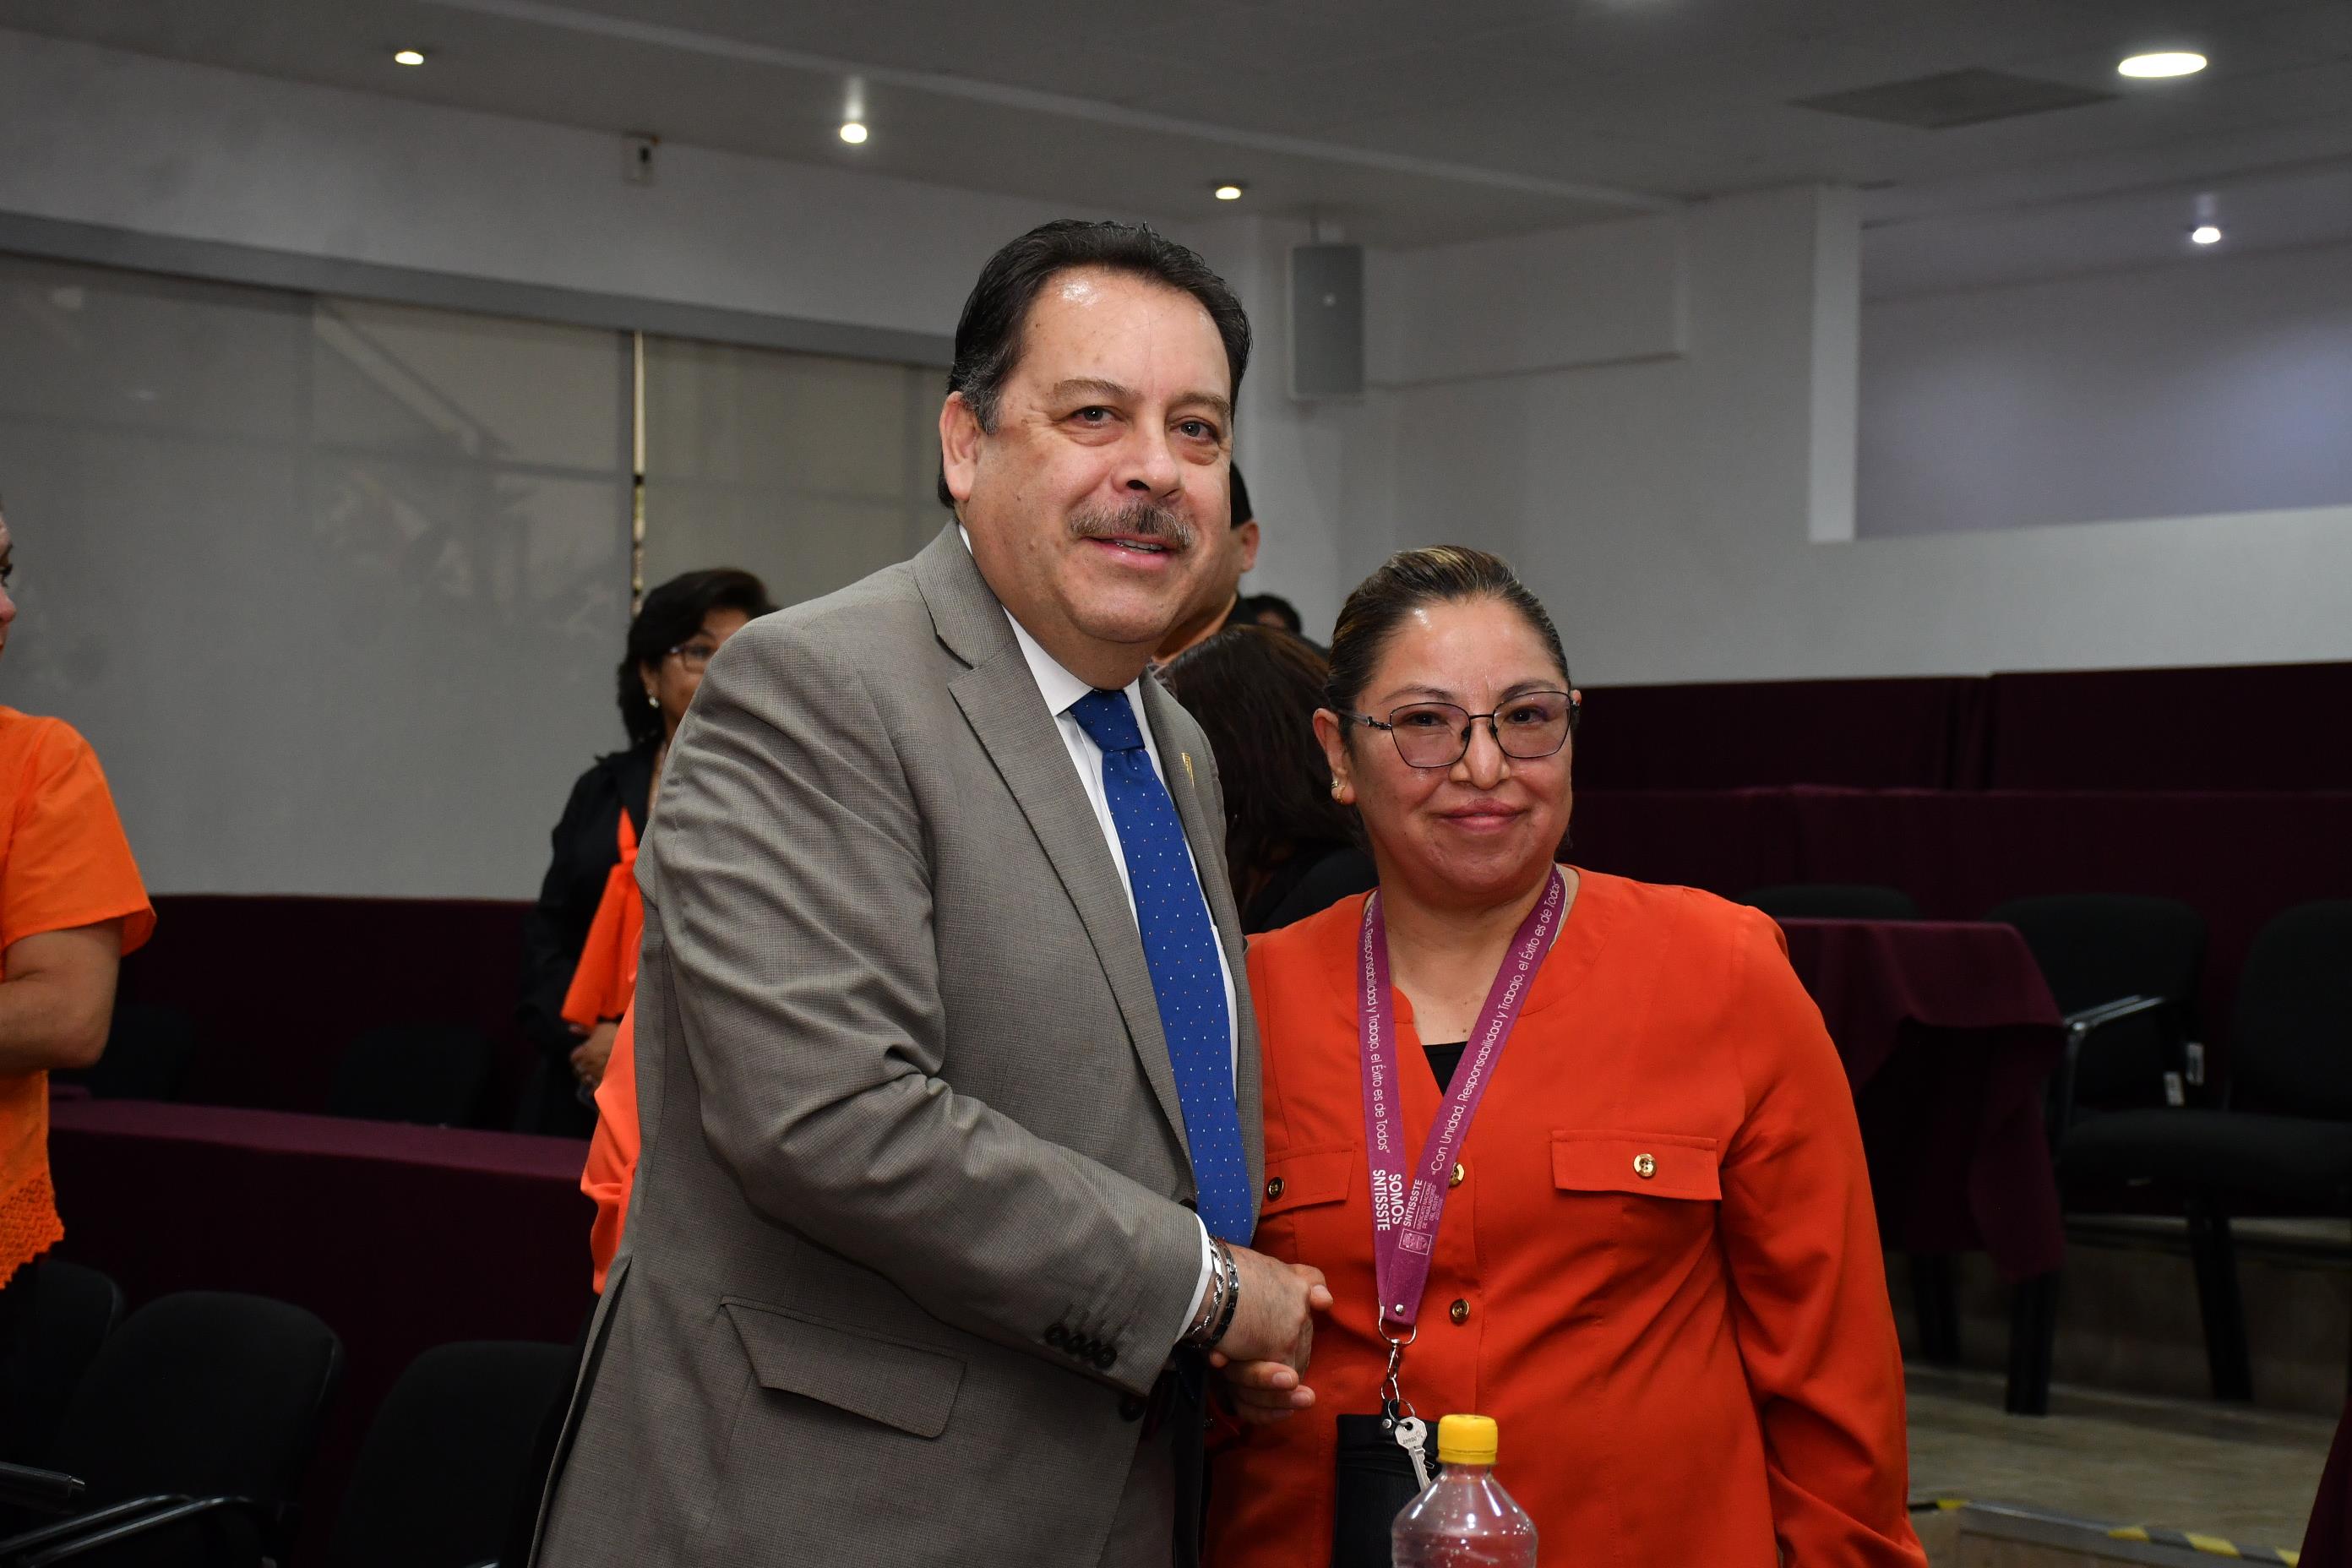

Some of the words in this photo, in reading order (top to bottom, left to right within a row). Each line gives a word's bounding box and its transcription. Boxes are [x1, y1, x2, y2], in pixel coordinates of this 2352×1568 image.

[1540, 908, 1553, 924] de
[1534, 923, 1546, 937] es
[1518, 937, 1540, 961] Éxito
[1364, 928, 1378, 1005] Responsabilidad
[1518, 960, 1528, 971] el
[1498, 973, 1525, 1011] Trabajo,
[1366, 1004, 1377, 1014] y
[1495, 1010, 1509, 1020] y
[1368, 1014, 1380, 1052] Trabajo,
[1371, 1054, 1381, 1064] el
[1457, 1019, 1503, 1102] Responsabilidad
[1372, 1064, 1386, 1086] Éxito
[1374, 1089, 1383, 1101] es
[1375, 1102, 1385, 1118] de
[1440, 1104, 1467, 1144] Unidad,
[1372, 1169, 1391, 1231] SNTISSSTE
[1389, 1173, 1405, 1225] SOMOS
[1403, 1179, 1423, 1228] SNTISSSTE
